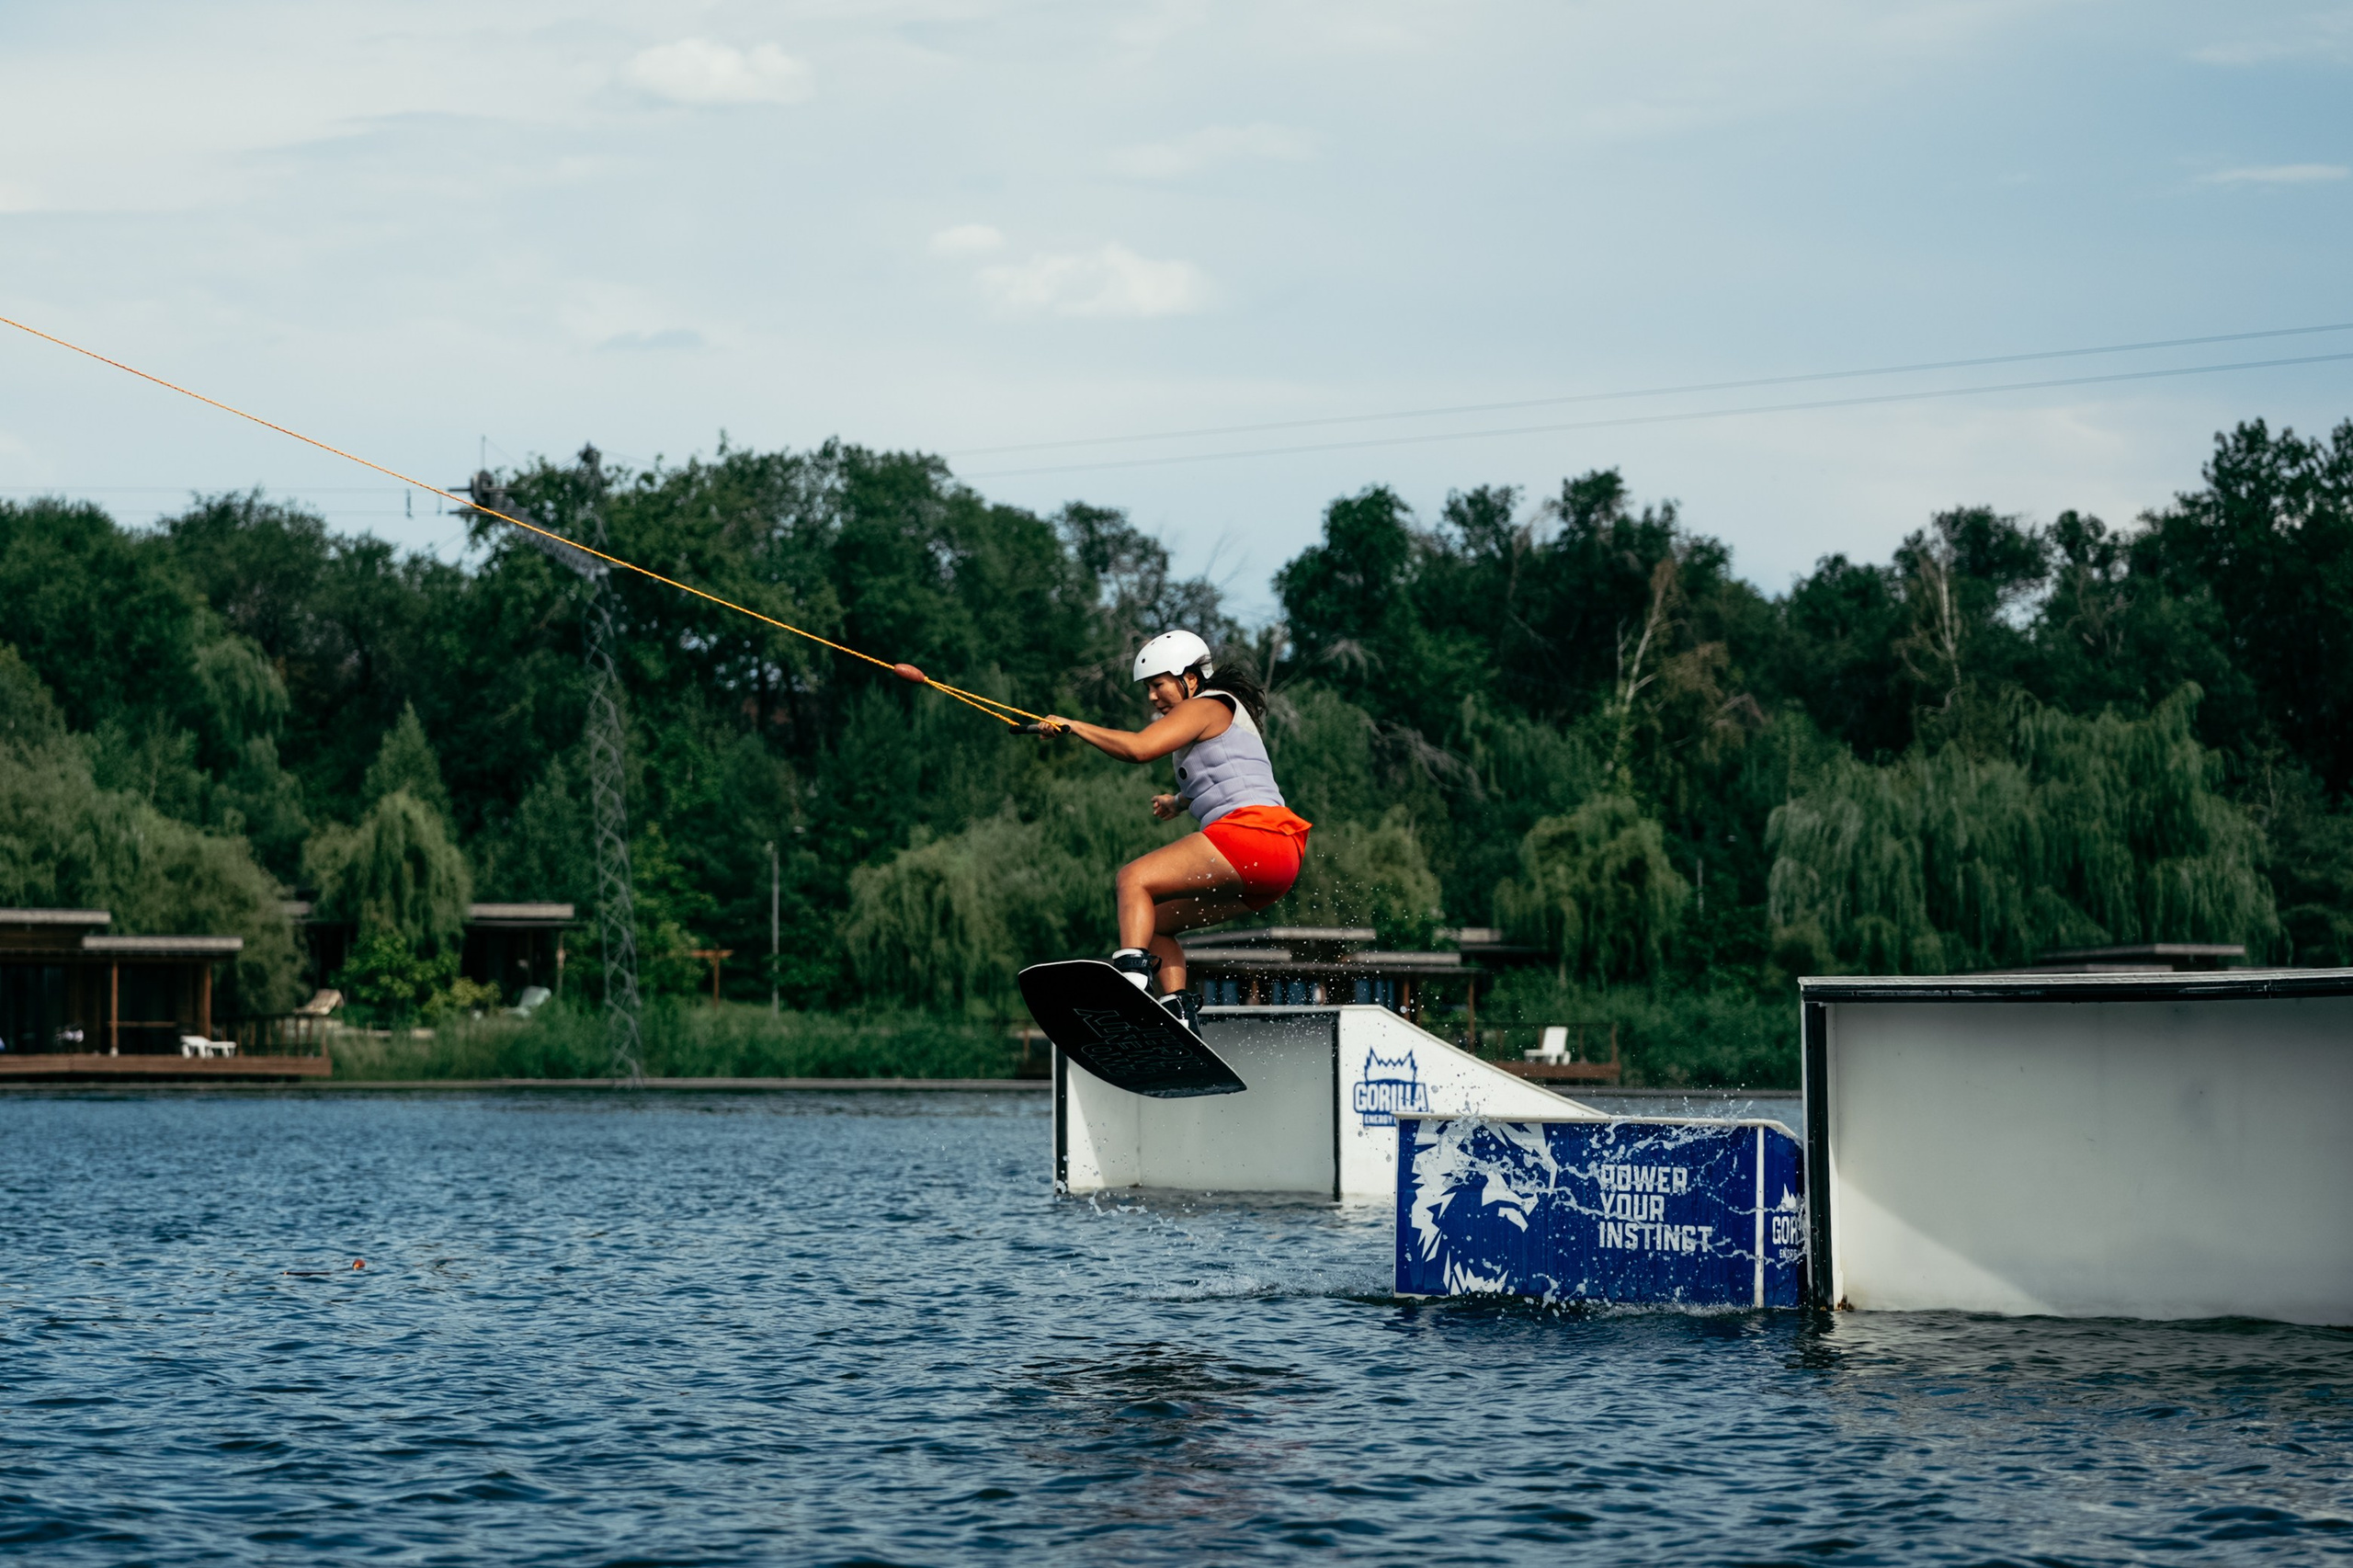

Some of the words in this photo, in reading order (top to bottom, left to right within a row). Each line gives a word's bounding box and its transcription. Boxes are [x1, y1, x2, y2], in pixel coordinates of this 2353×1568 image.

[1354, 1084, 1427, 1112] GORILLA
[1600, 1164, 1688, 1194] POWER
[1599, 1192, 1665, 1221] YOUR
[1599, 1221, 1713, 1252] INSTINCT
